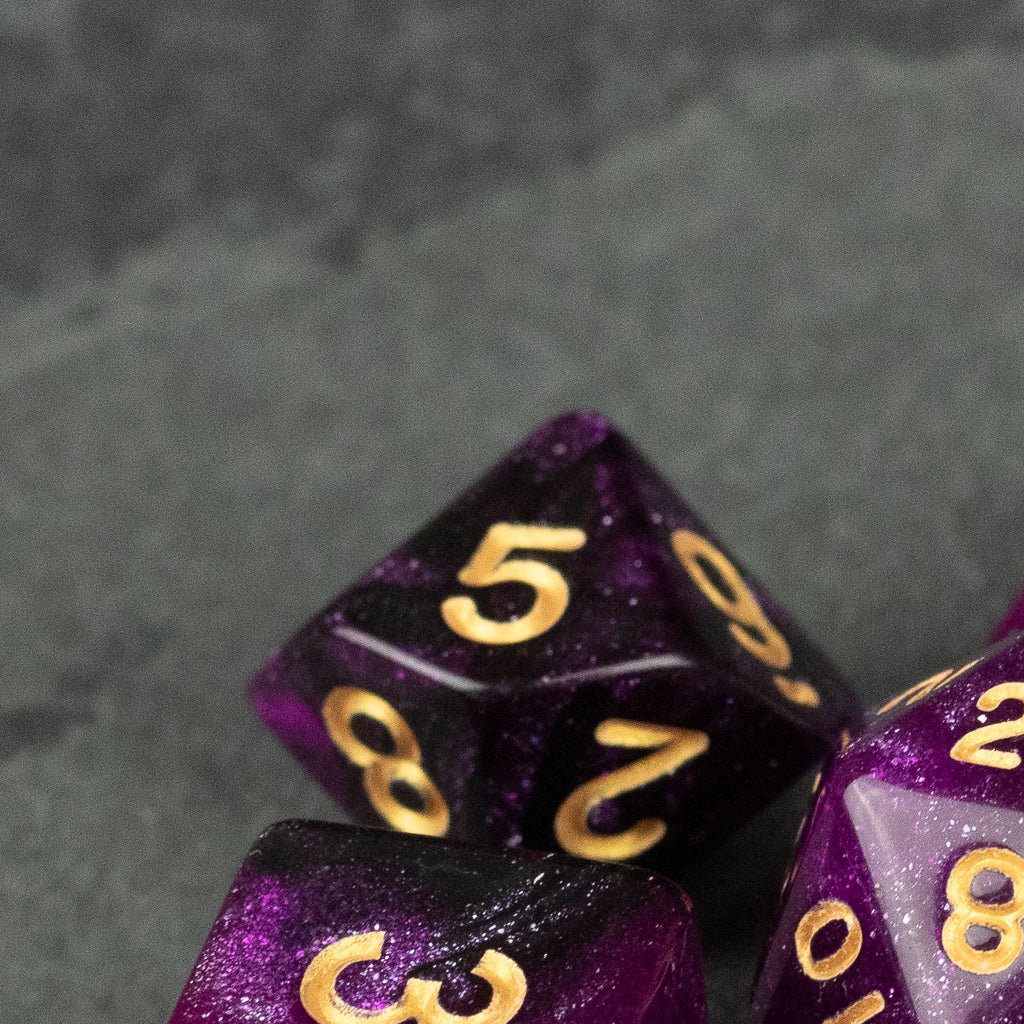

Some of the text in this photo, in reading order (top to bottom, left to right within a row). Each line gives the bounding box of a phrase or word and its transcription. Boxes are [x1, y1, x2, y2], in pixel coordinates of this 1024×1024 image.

[440, 521, 588, 647] 5
[323, 686, 452, 838] 8
[554, 719, 709, 864] 2
